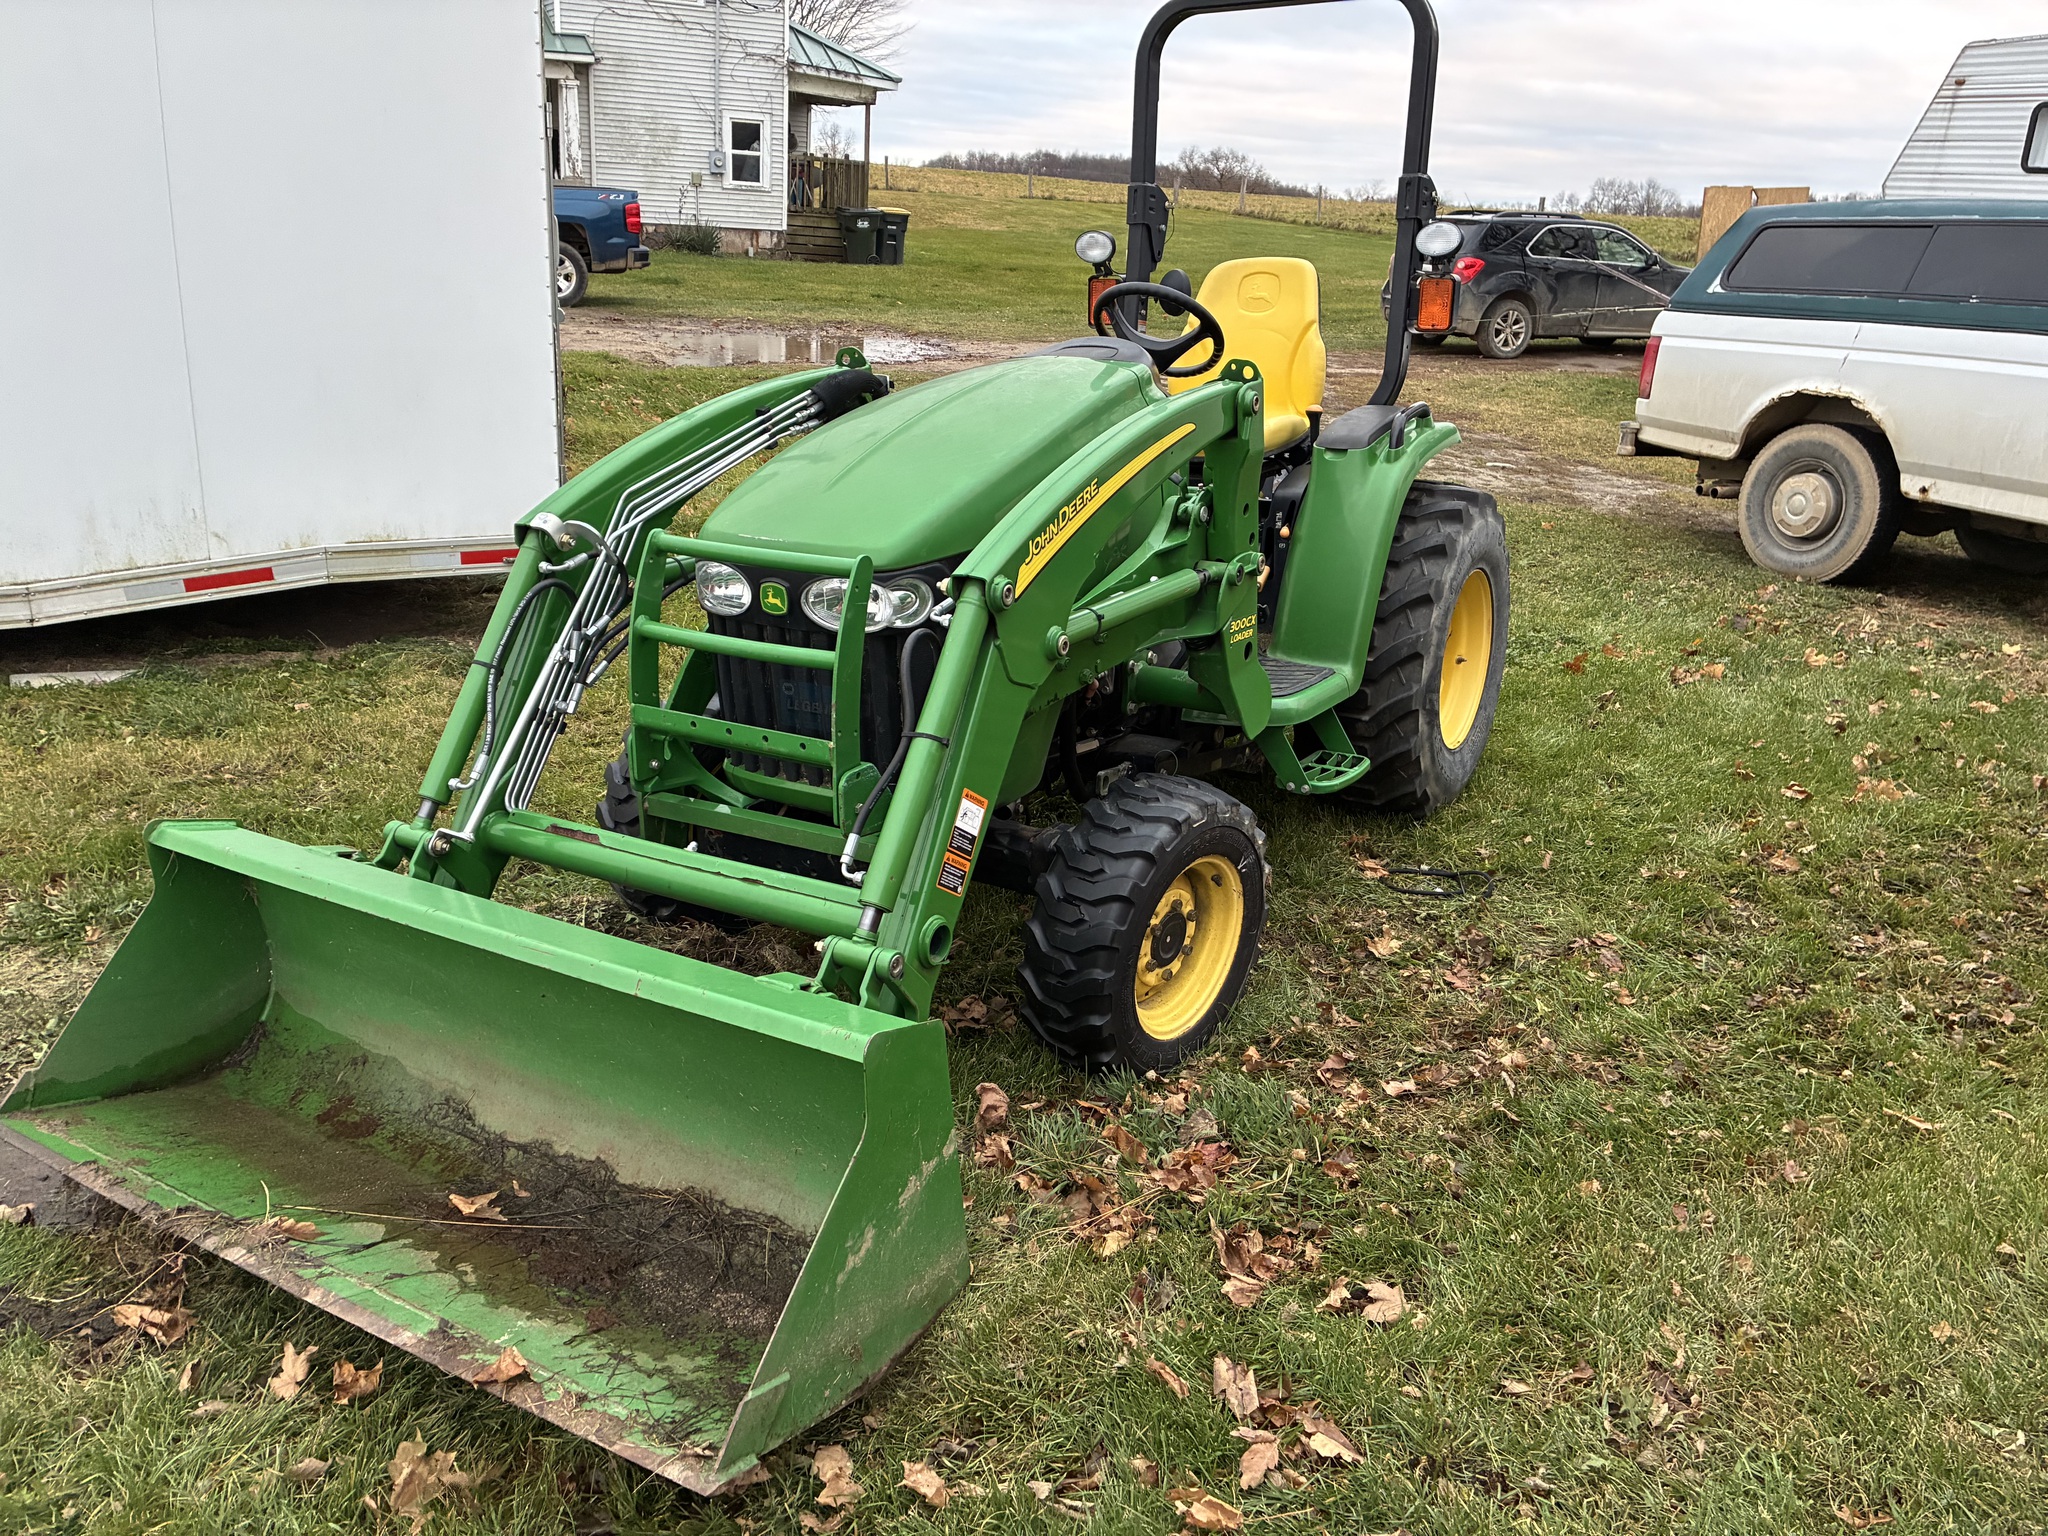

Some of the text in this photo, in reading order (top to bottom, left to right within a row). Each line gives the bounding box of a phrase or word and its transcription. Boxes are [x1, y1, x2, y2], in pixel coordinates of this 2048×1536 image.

[1025, 478, 1100, 565] JOHN DEERE
[1230, 614, 1257, 643] 300CX LOADER
